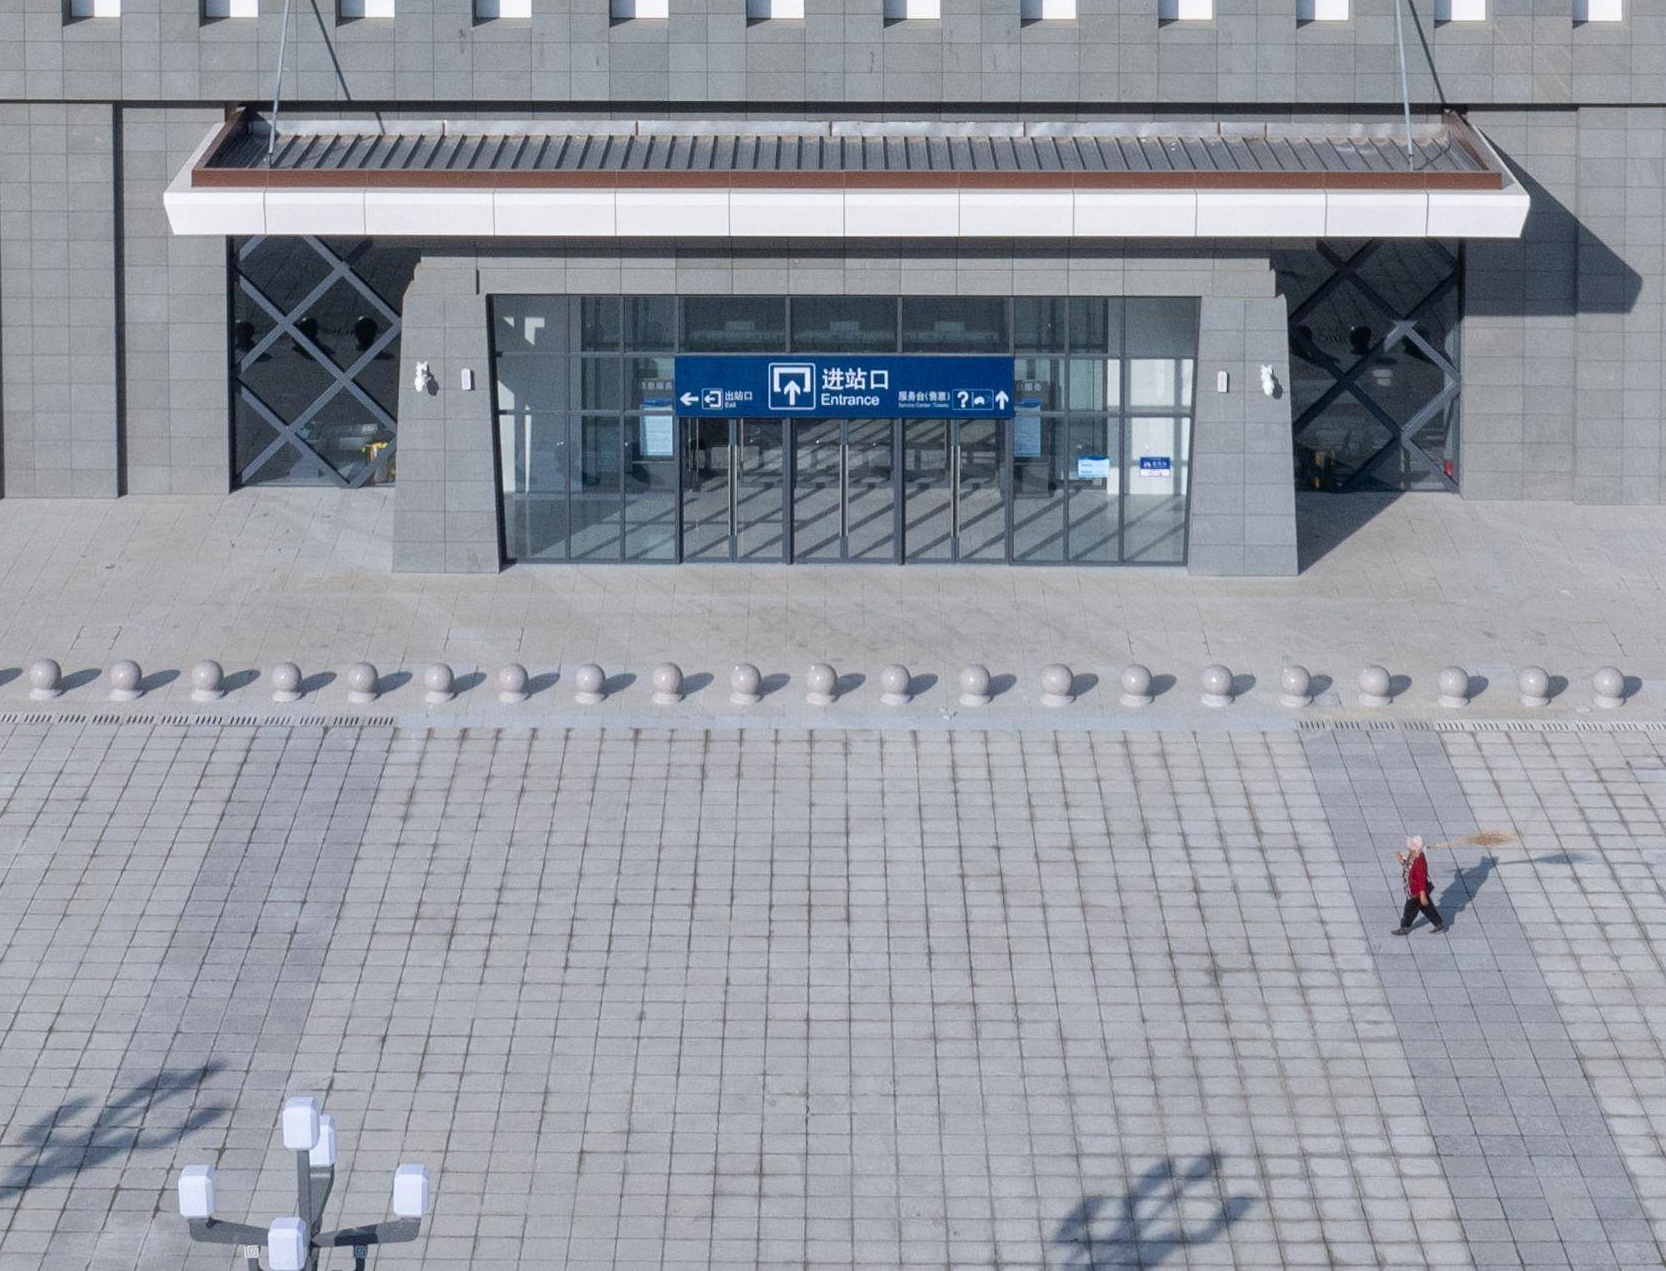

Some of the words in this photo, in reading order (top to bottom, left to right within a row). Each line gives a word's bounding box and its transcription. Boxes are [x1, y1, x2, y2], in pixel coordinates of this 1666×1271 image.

[822, 367, 889, 391] 进站口
[724, 390, 753, 401] 出站口
[821, 393, 880, 406] Entrance
